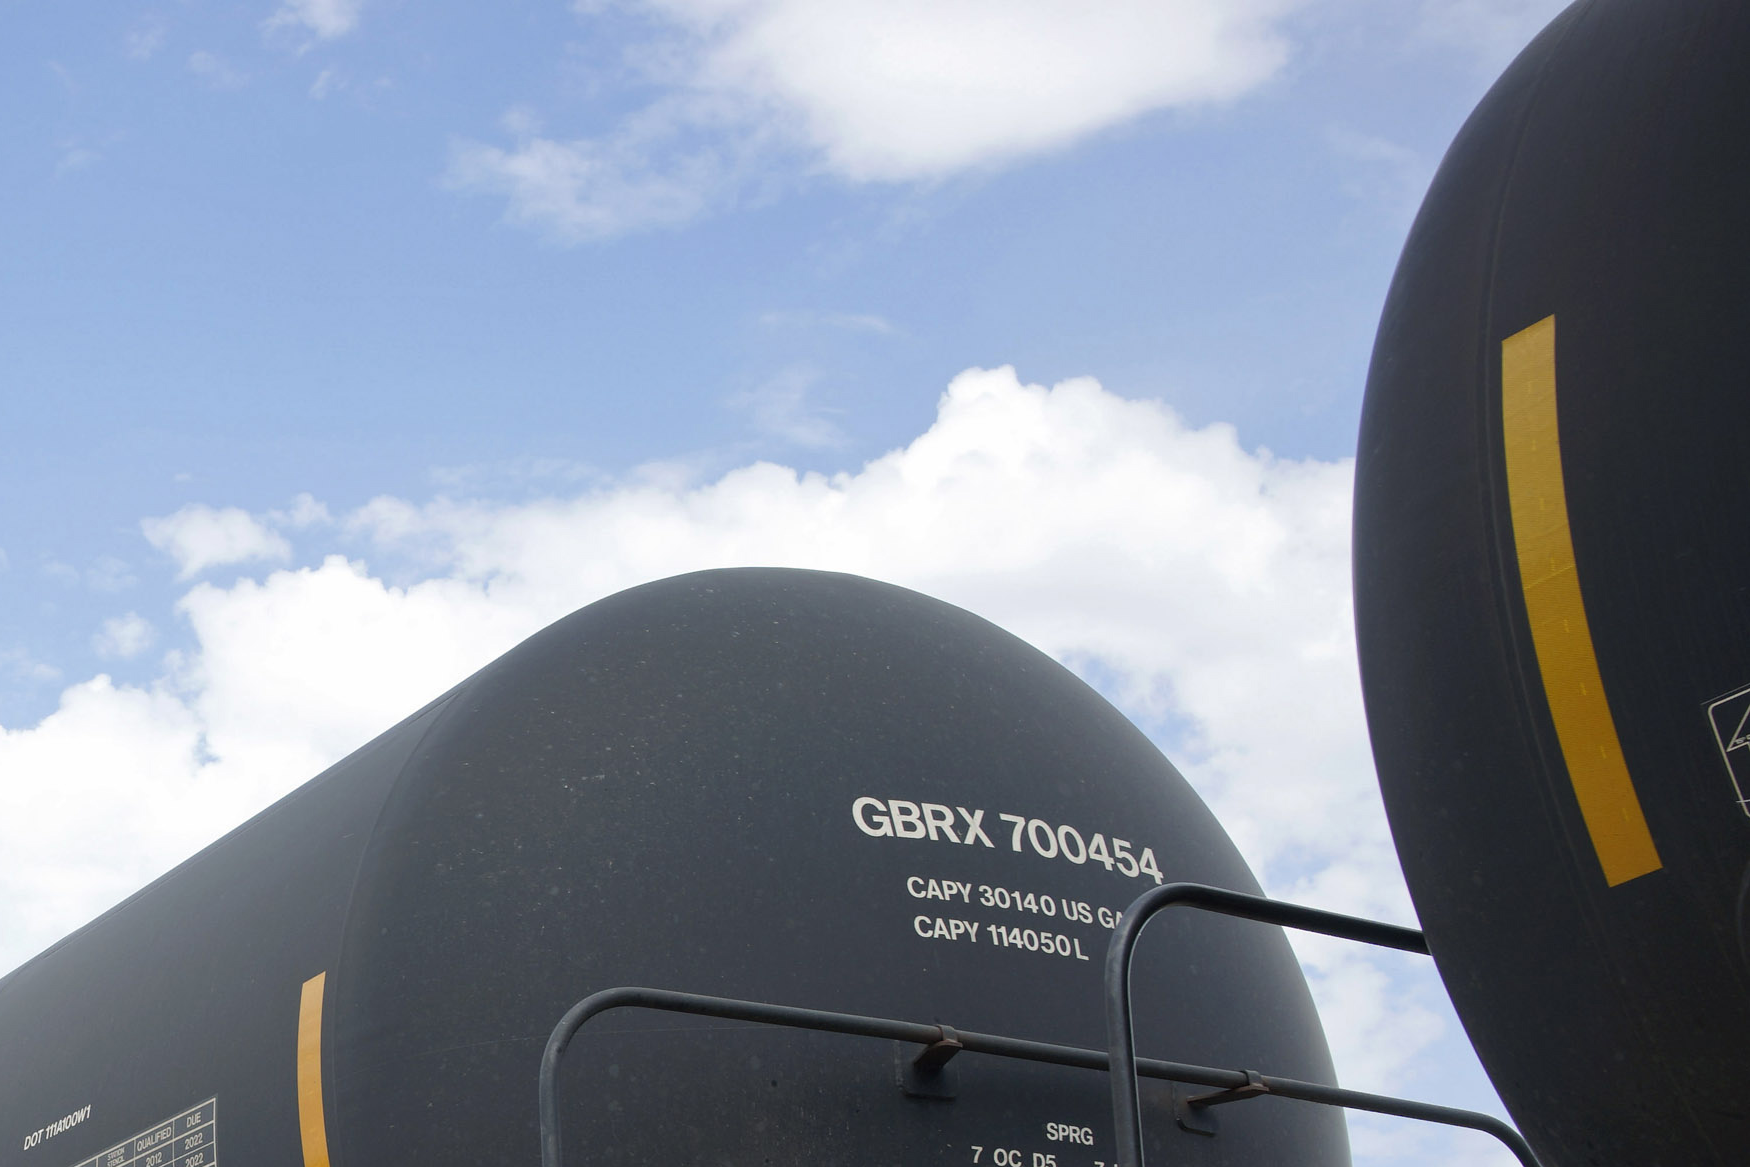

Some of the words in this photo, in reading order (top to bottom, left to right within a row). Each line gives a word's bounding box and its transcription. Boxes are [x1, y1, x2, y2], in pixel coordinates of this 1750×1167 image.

[852, 796, 995, 849] GBRX
[999, 812, 1164, 885] 700454
[907, 876, 973, 904] CAPY
[979, 885, 1056, 917] 30140
[1061, 899, 1093, 925] US
[914, 915, 979, 943] CAPY
[24, 1128, 44, 1151] DOT
[137, 1127, 172, 1152] QUALIFIED
[186, 1112, 201, 1128] DUE
[1046, 1122, 1094, 1146] SPRG
[146, 1152, 162, 1167] 2012
[185, 1133, 203, 1149] 2022
[971, 1145, 983, 1163] 7
[993, 1148, 1022, 1167] OC
